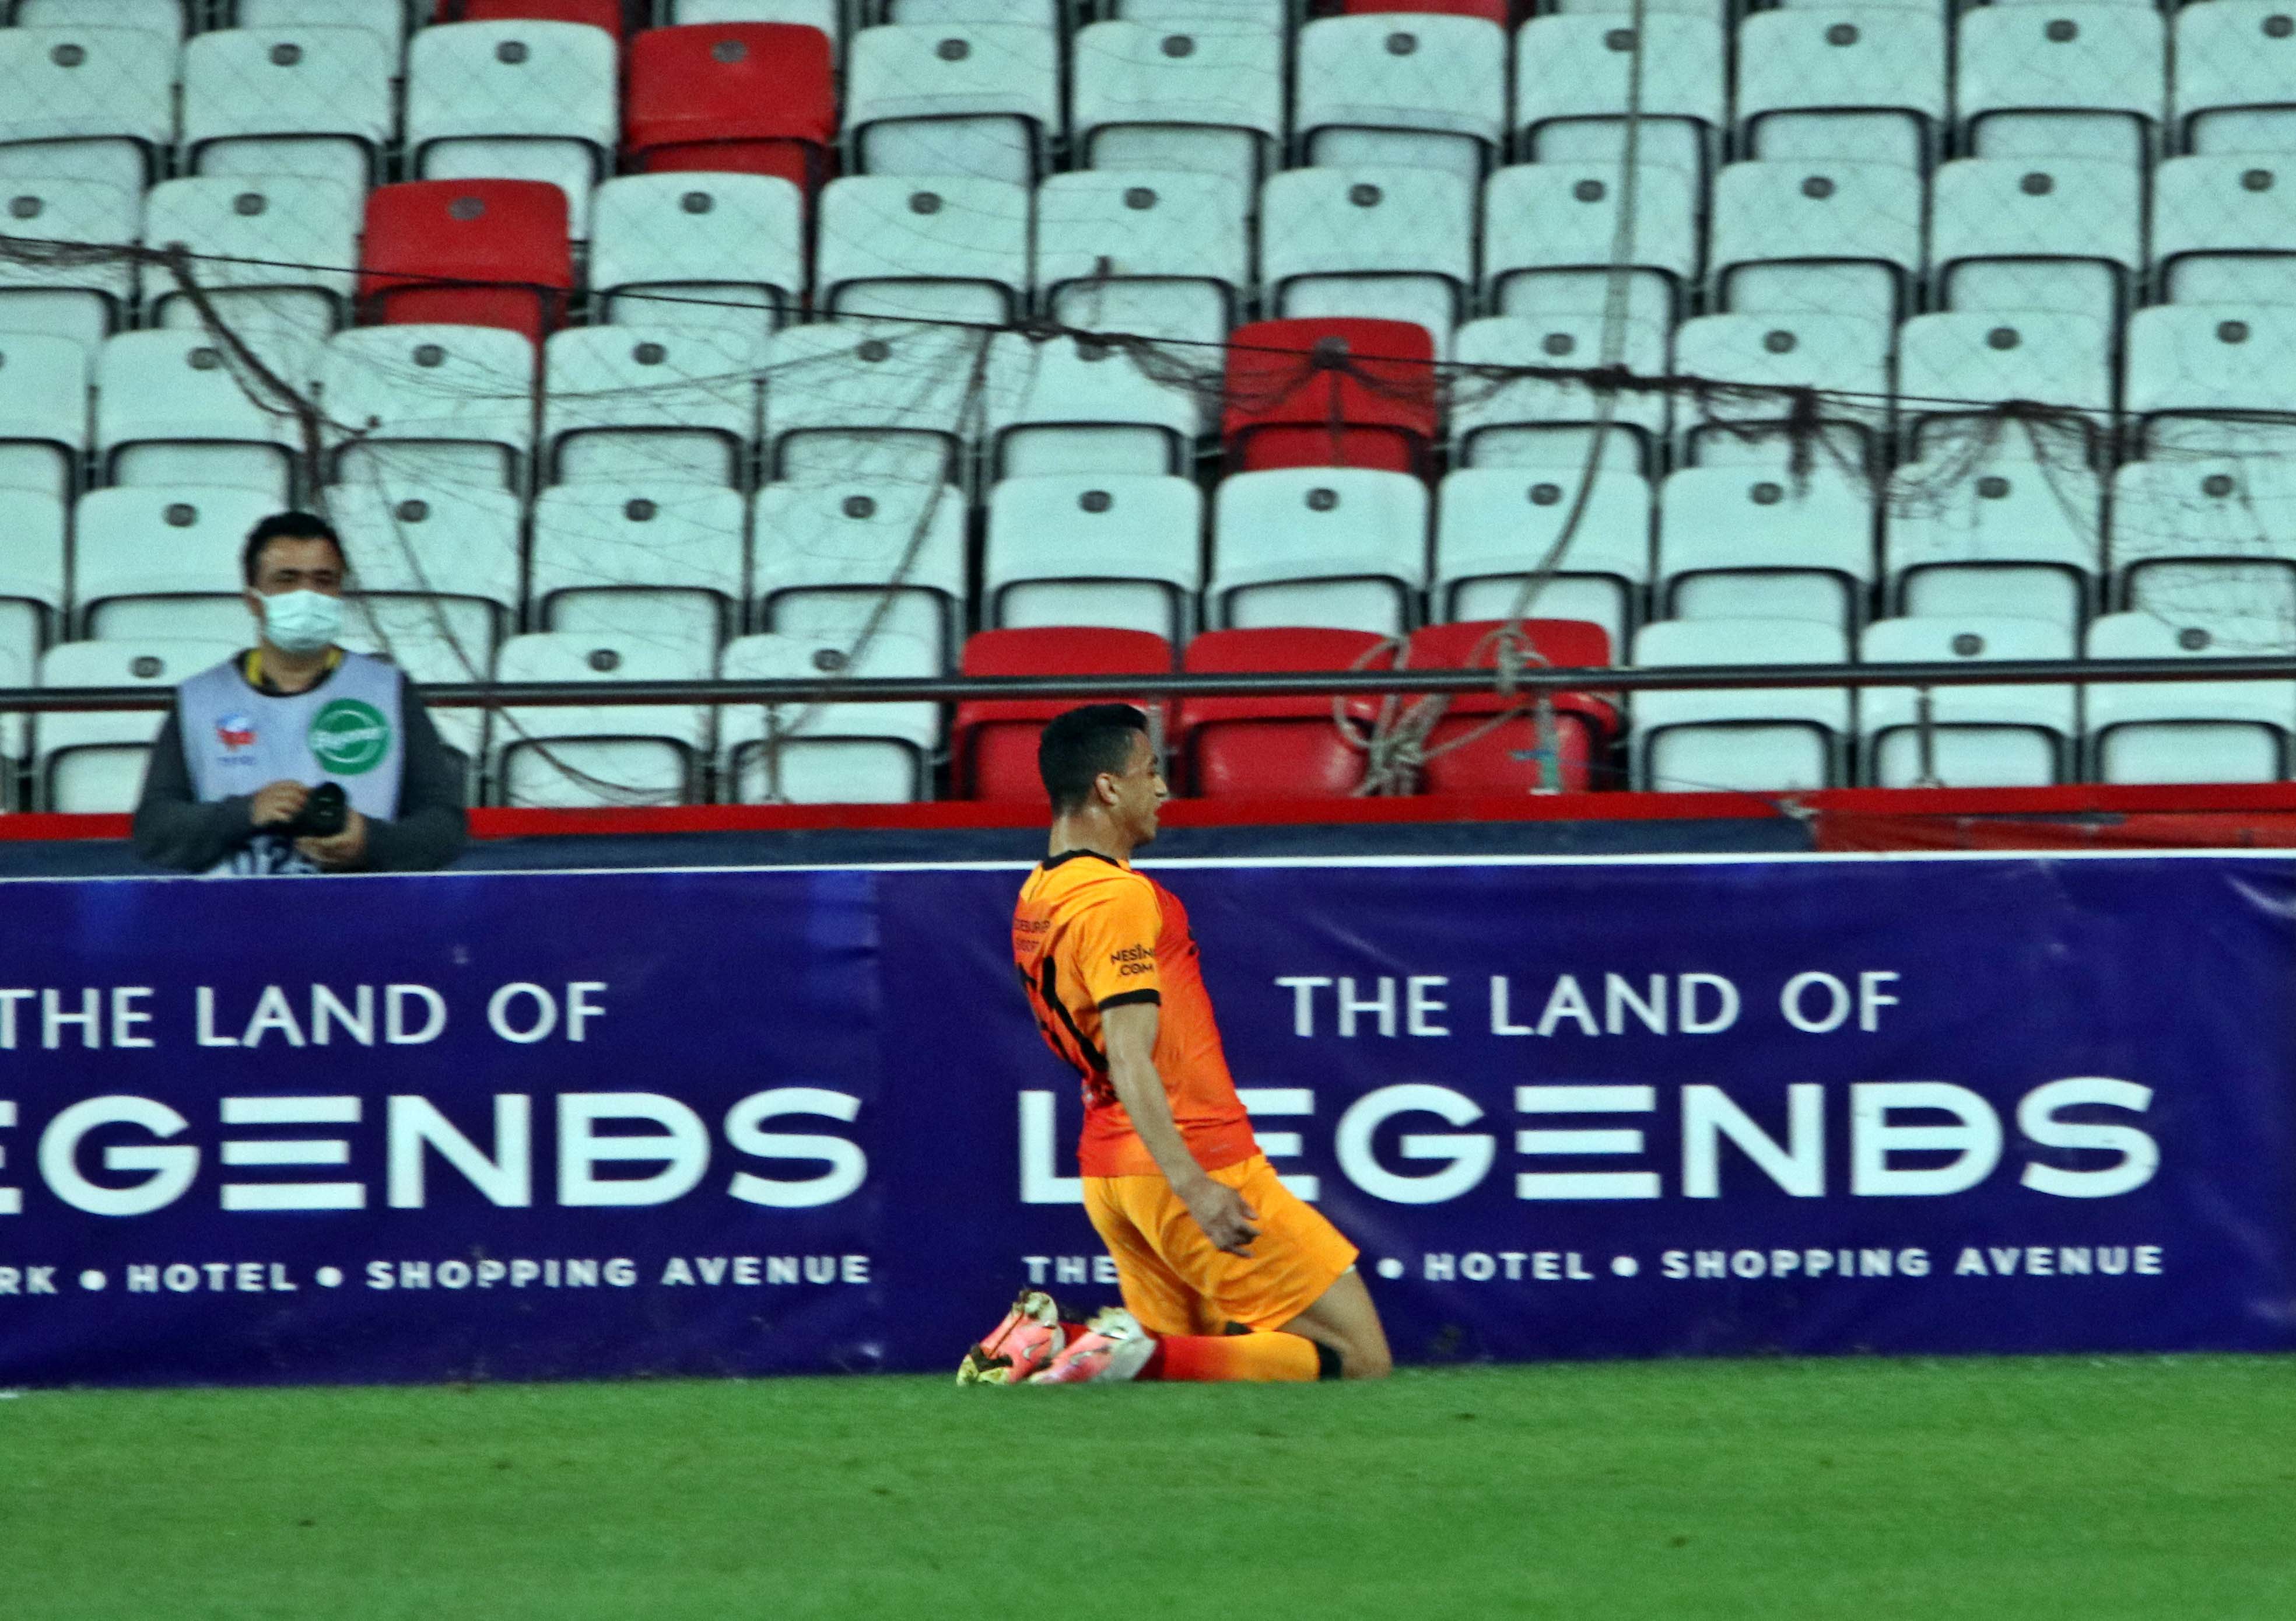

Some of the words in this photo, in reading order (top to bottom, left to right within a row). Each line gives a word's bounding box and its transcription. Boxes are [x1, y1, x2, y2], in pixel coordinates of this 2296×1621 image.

[0, 986, 155, 1050] THE
[197, 983, 447, 1048] LAND
[486, 981, 608, 1044] OF
[1274, 975, 1450, 1038] THE
[1489, 972, 1740, 1037] LAND
[1780, 971, 1900, 1034] OF
[0, 1087, 868, 1216] GENDS
[127, 1262, 297, 1293] HOTEL
[366, 1257, 637, 1290] SHOPPING
[661, 1255, 870, 1286] AVENUE
[1423, 1251, 1594, 1282] HOTEL
[1661, 1247, 1930, 1279] SHOPPING
[1954, 1245, 2162, 1276] AVENUE
